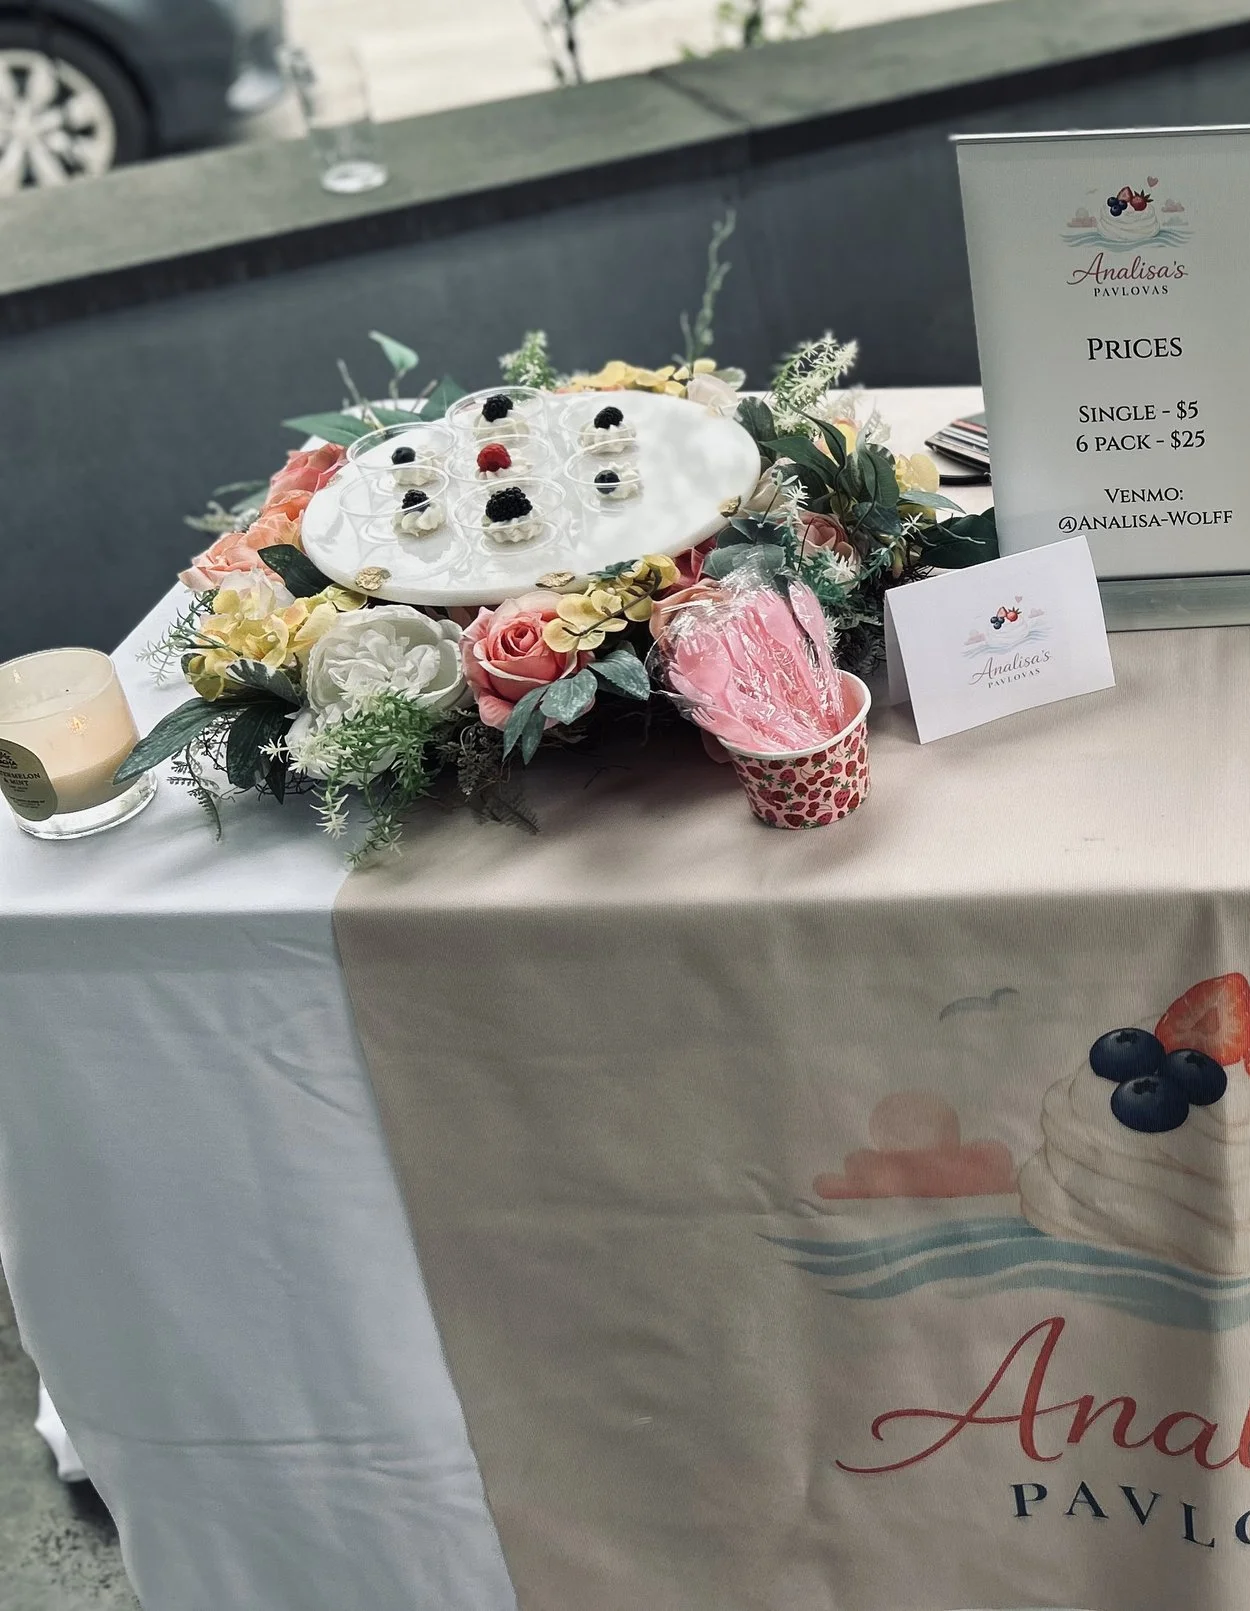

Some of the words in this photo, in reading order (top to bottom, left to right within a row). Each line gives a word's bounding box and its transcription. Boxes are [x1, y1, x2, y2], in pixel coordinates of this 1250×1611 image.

[1066, 252, 1189, 285] Analisa's
[1093, 285, 1169, 297] PAVLOVAS
[1087, 337, 1183, 360] PRICES
[1079, 405, 1157, 423] SINGLE
[1176, 400, 1199, 420] $5
[1076, 434, 1089, 453] 6
[1094, 434, 1152, 452] PACK
[1170, 430, 1206, 450] $25
[1104, 487, 1184, 503] VENMO:
[1058, 510, 1233, 533] @ANALISA-WOLFF
[969, 649, 1052, 685] Analisa's
[987, 667, 1041, 689] PAVLOVAS
